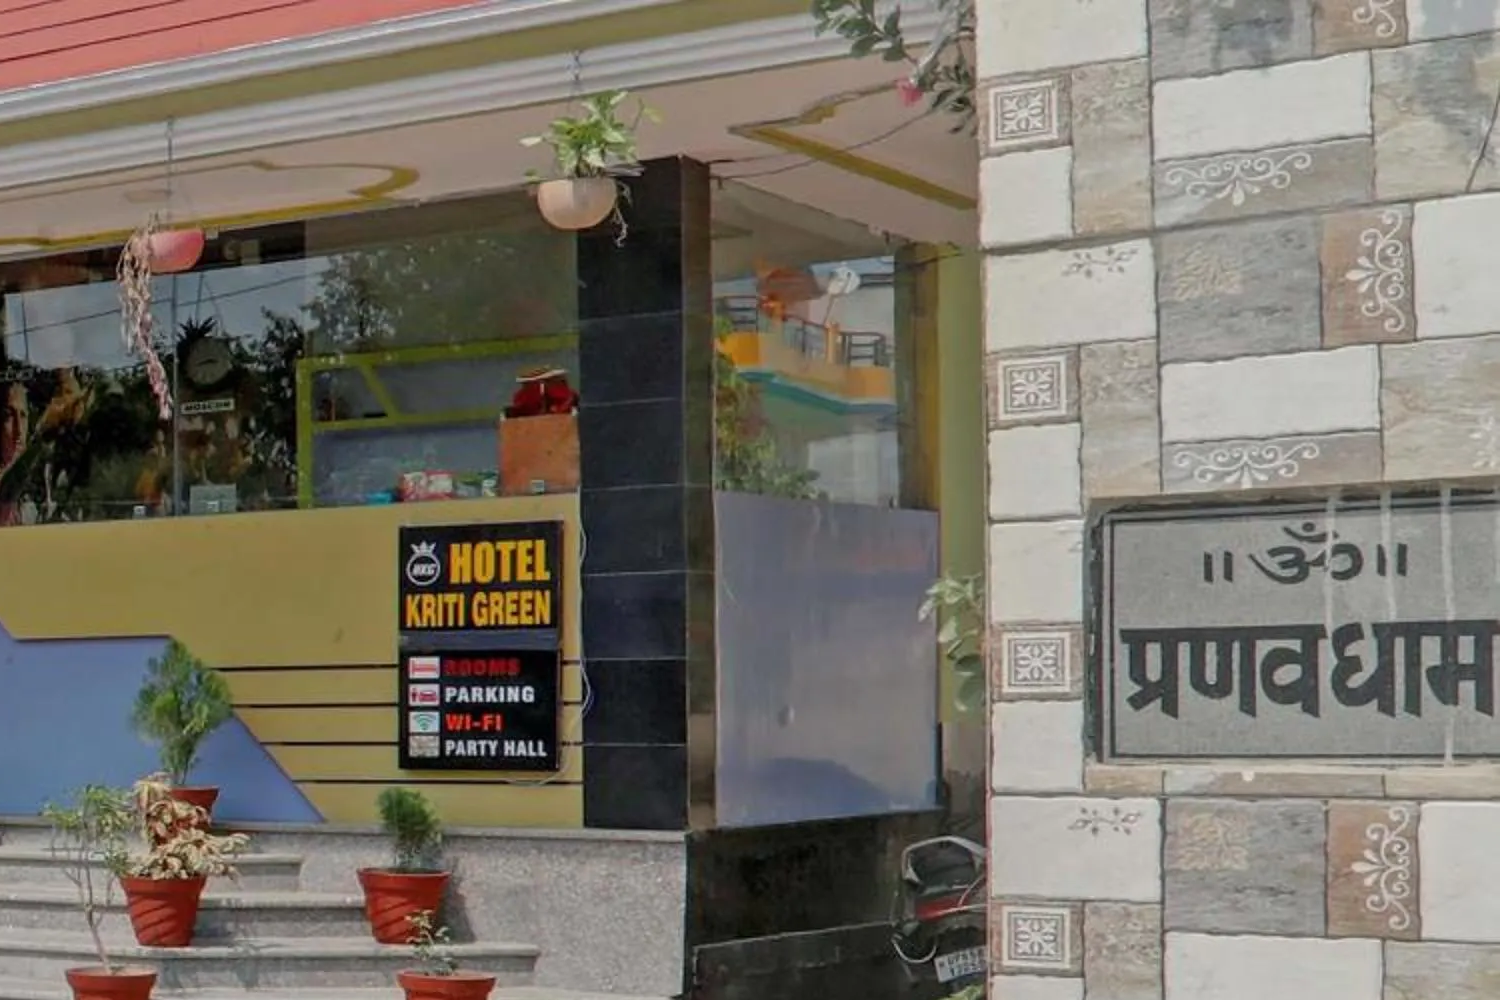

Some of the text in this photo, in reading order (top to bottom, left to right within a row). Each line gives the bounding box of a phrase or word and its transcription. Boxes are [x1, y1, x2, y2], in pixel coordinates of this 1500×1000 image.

[449, 539, 550, 584] HOTEL
[406, 590, 551, 627] KRITI GREEN
[444, 658, 521, 676] ROOMS
[1119, 619, 1500, 718] प्रणवधाम
[445, 685, 536, 703] PARKING
[445, 713, 503, 731] WI-FI
[445, 739, 548, 757] PARTY HALL
